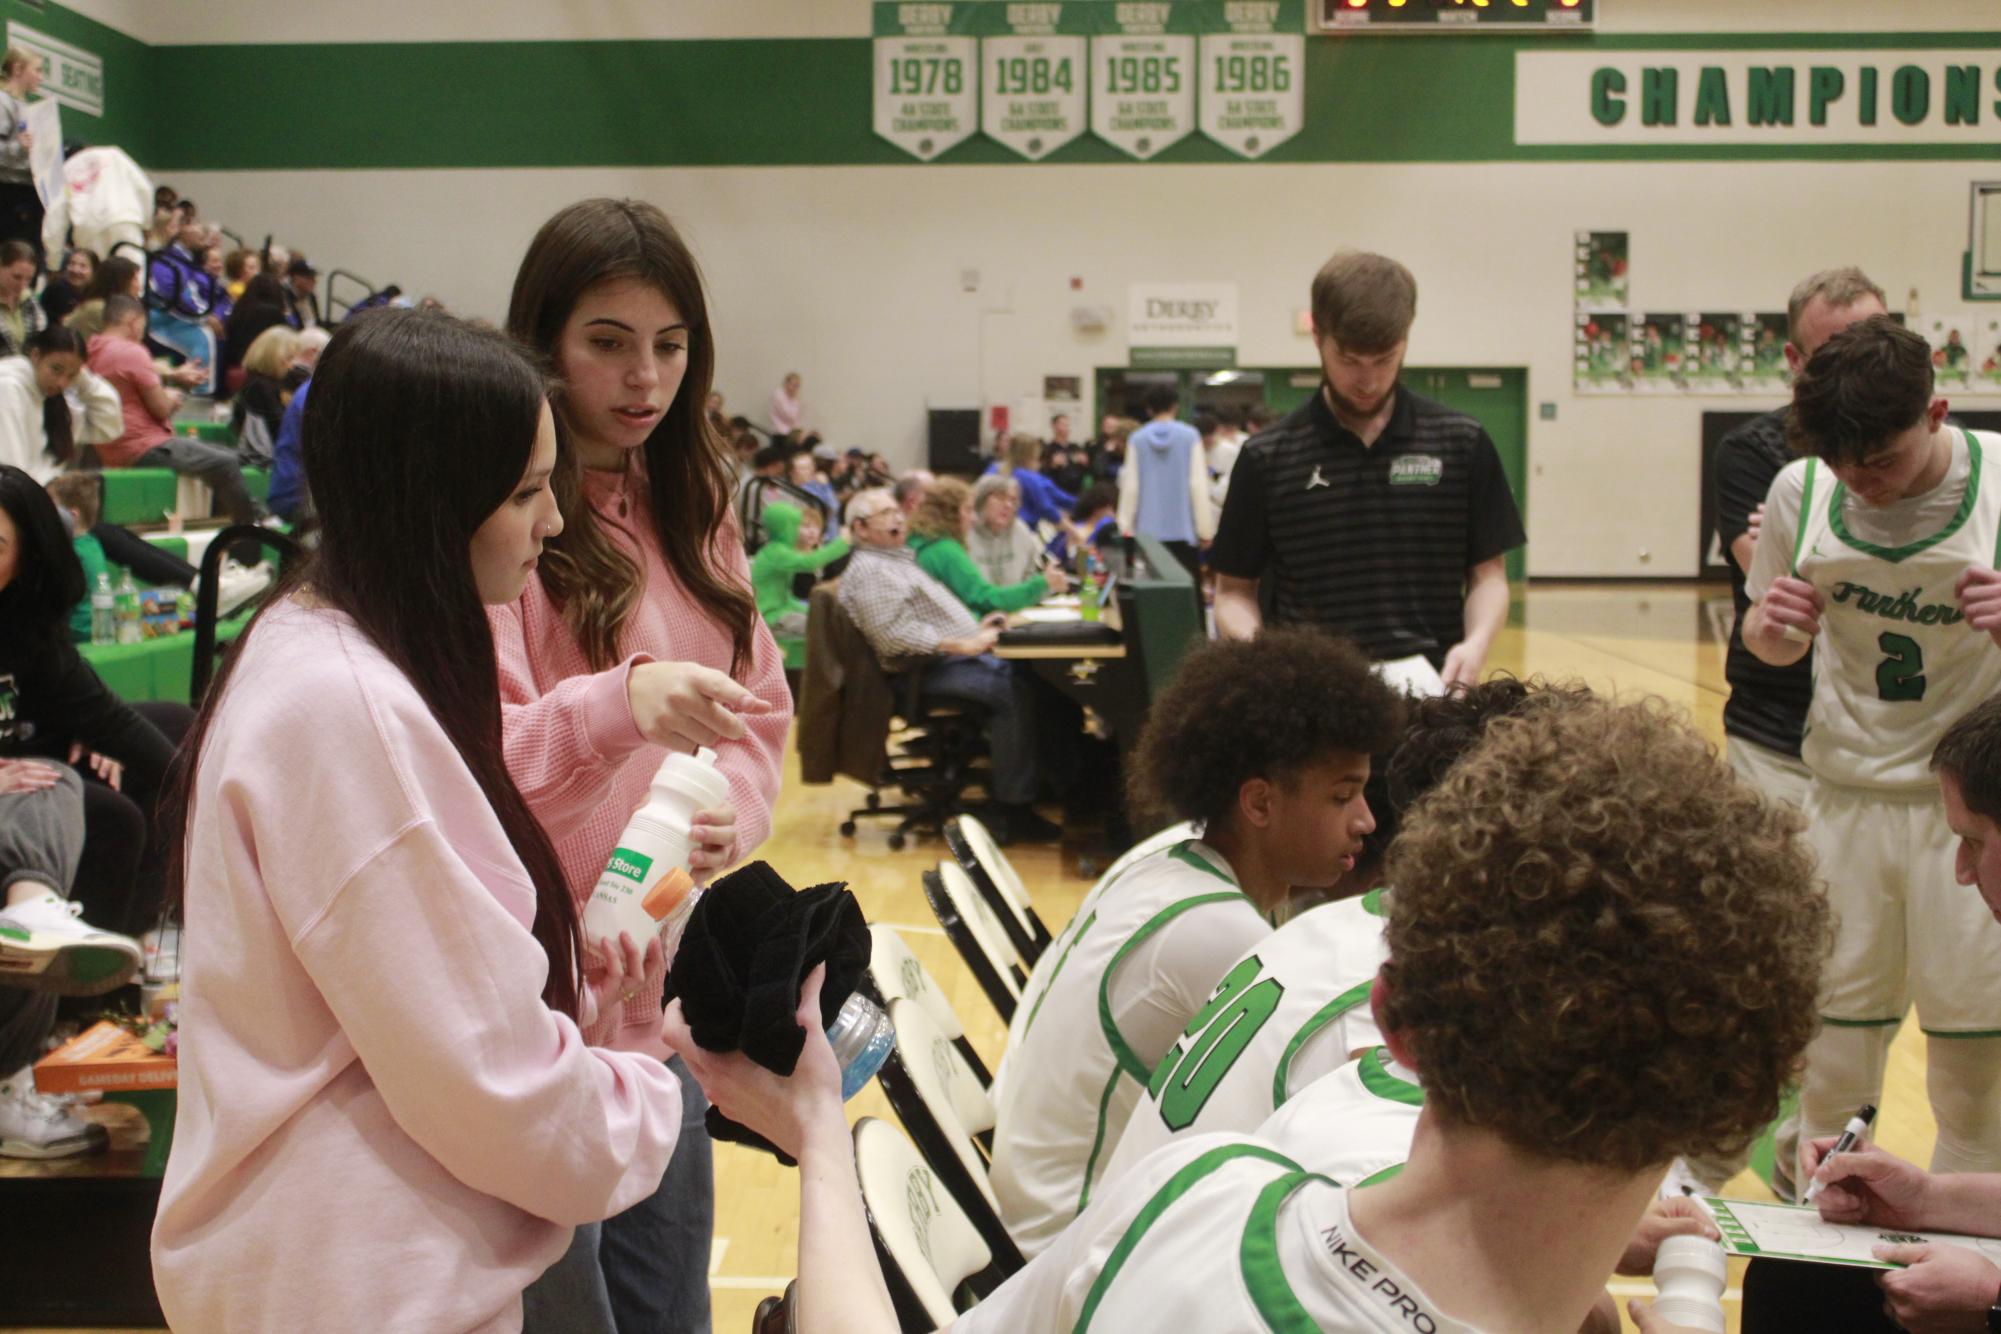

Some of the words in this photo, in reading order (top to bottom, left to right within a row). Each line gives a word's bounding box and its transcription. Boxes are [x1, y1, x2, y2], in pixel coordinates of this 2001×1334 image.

[889, 58, 963, 94] 1978
[996, 57, 1073, 94] 1984
[1107, 56, 1181, 93] 1985
[1214, 56, 1290, 93] 1986
[1589, 64, 2001, 128] CHAMPION
[1876, 631, 1926, 702] 2
[1320, 1225, 1379, 1283] NIKE
[1372, 1277, 1437, 1334] PRO
